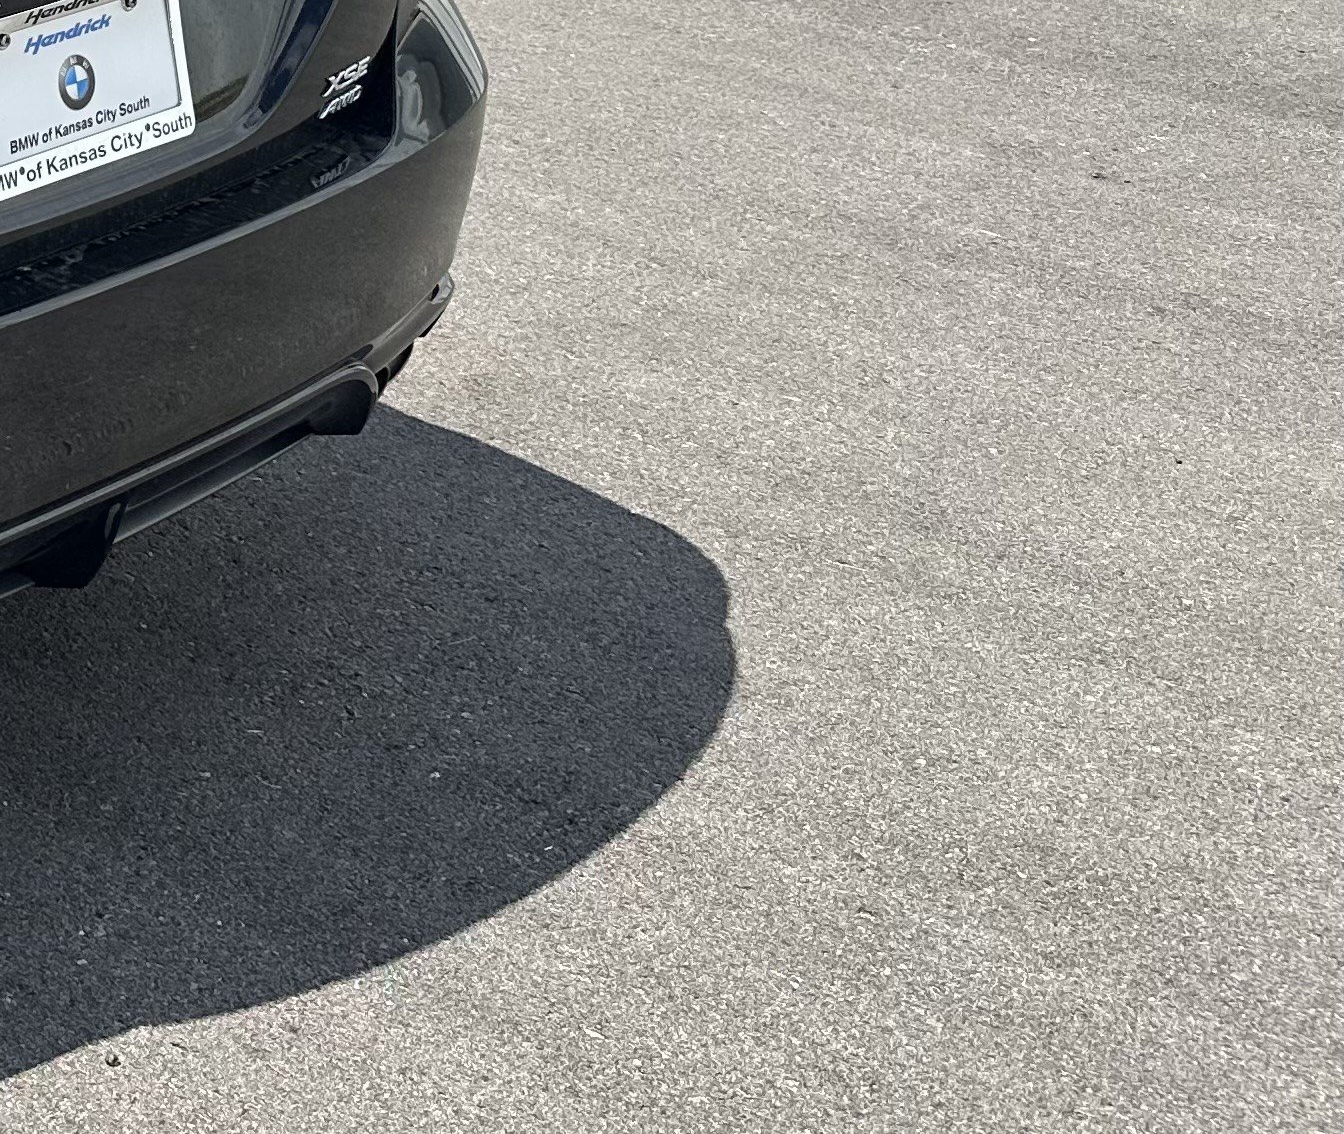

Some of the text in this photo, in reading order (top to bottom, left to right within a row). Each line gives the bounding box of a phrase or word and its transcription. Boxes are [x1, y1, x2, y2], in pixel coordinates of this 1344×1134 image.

[24, 14, 112, 55] Hendrick
[322, 56, 370, 97] XSE
[10, 95, 151, 155] BMW of Kansas City South
[26, 161, 43, 182] of
[45, 143, 107, 175] Kansas
[111, 129, 144, 154] City
[150, 112, 193, 139] South
